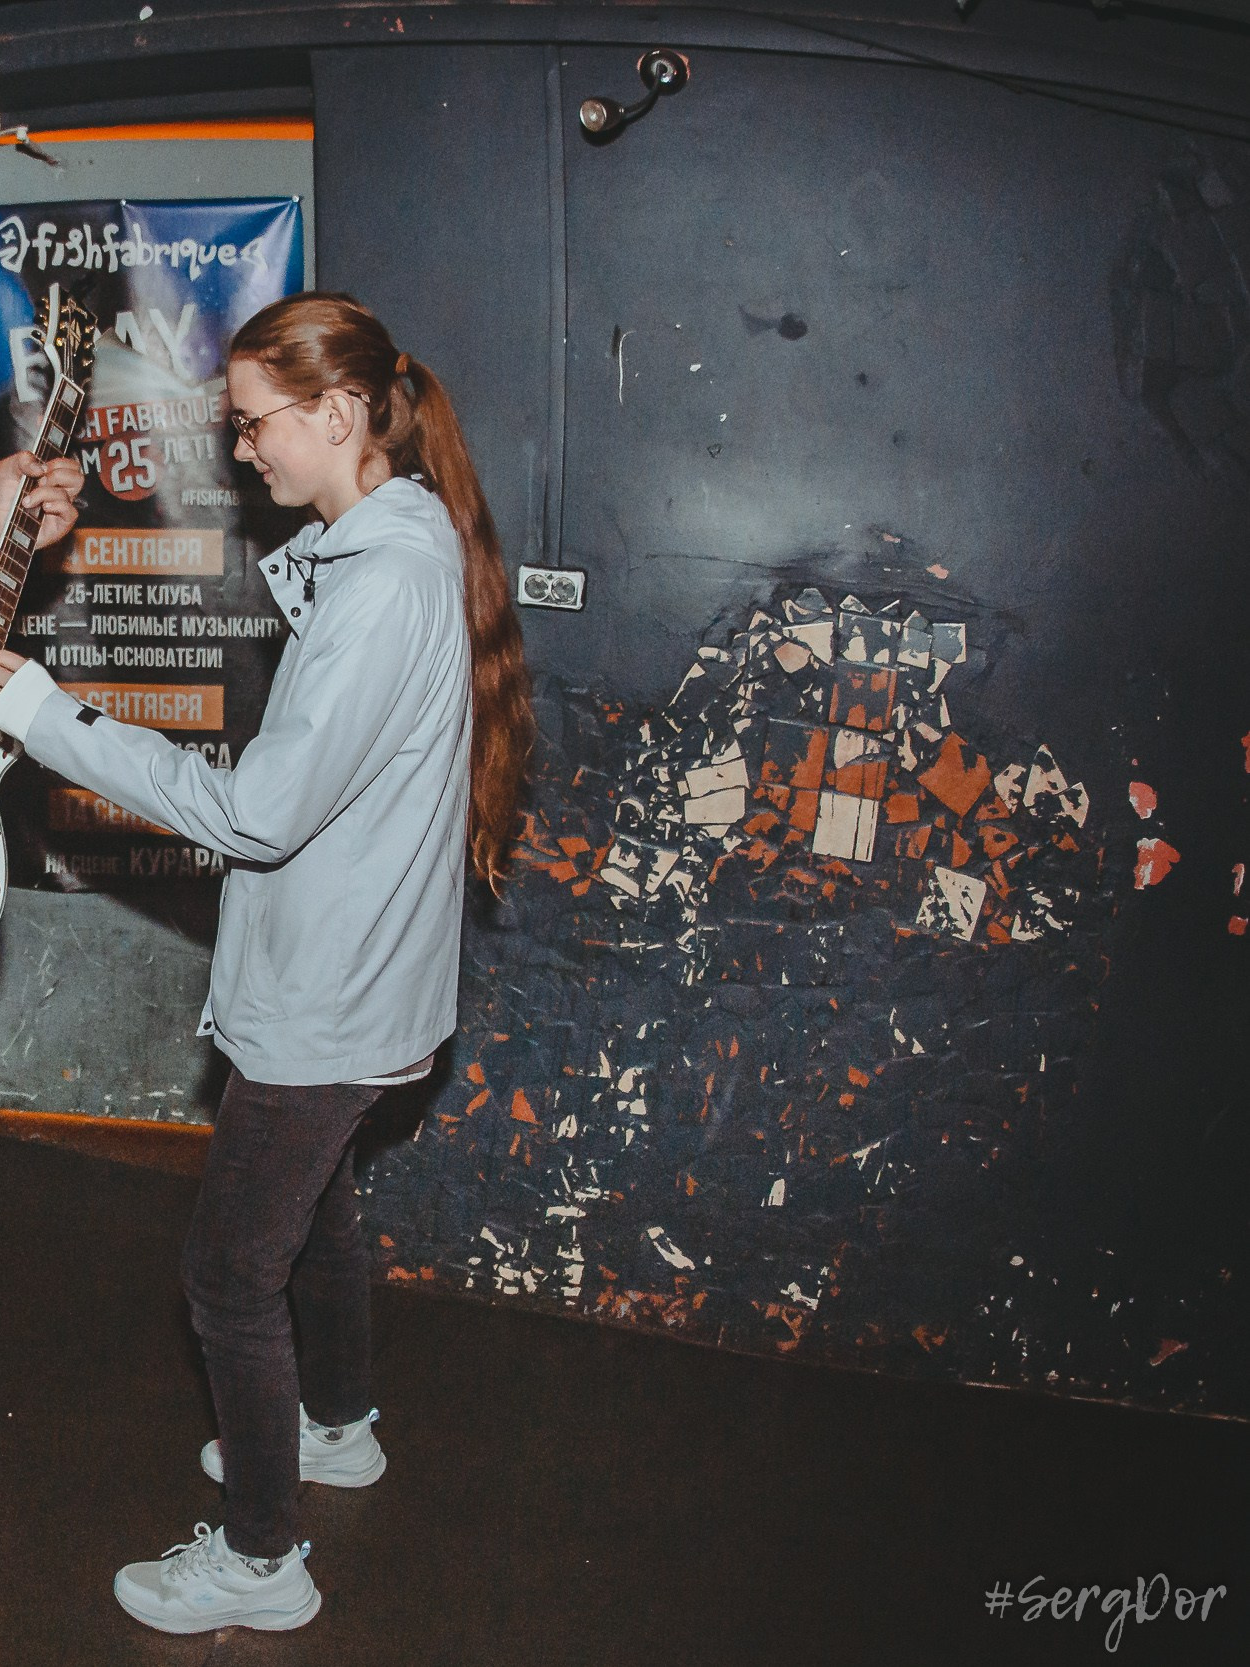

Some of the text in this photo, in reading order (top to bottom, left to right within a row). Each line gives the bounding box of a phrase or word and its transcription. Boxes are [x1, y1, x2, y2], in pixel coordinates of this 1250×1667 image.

[106, 396, 222, 435] FABRIQUE
[107, 437, 156, 492] 25
[164, 434, 213, 465] ЛЕТ!
[84, 536, 203, 567] СЕНТЯБРЯ
[147, 584, 203, 605] КЛУБА
[90, 614, 178, 637] ЛЮБИМЫЕ
[45, 644, 223, 668] И ОТЦЫ-ОСНОВАТЕЛИ!
